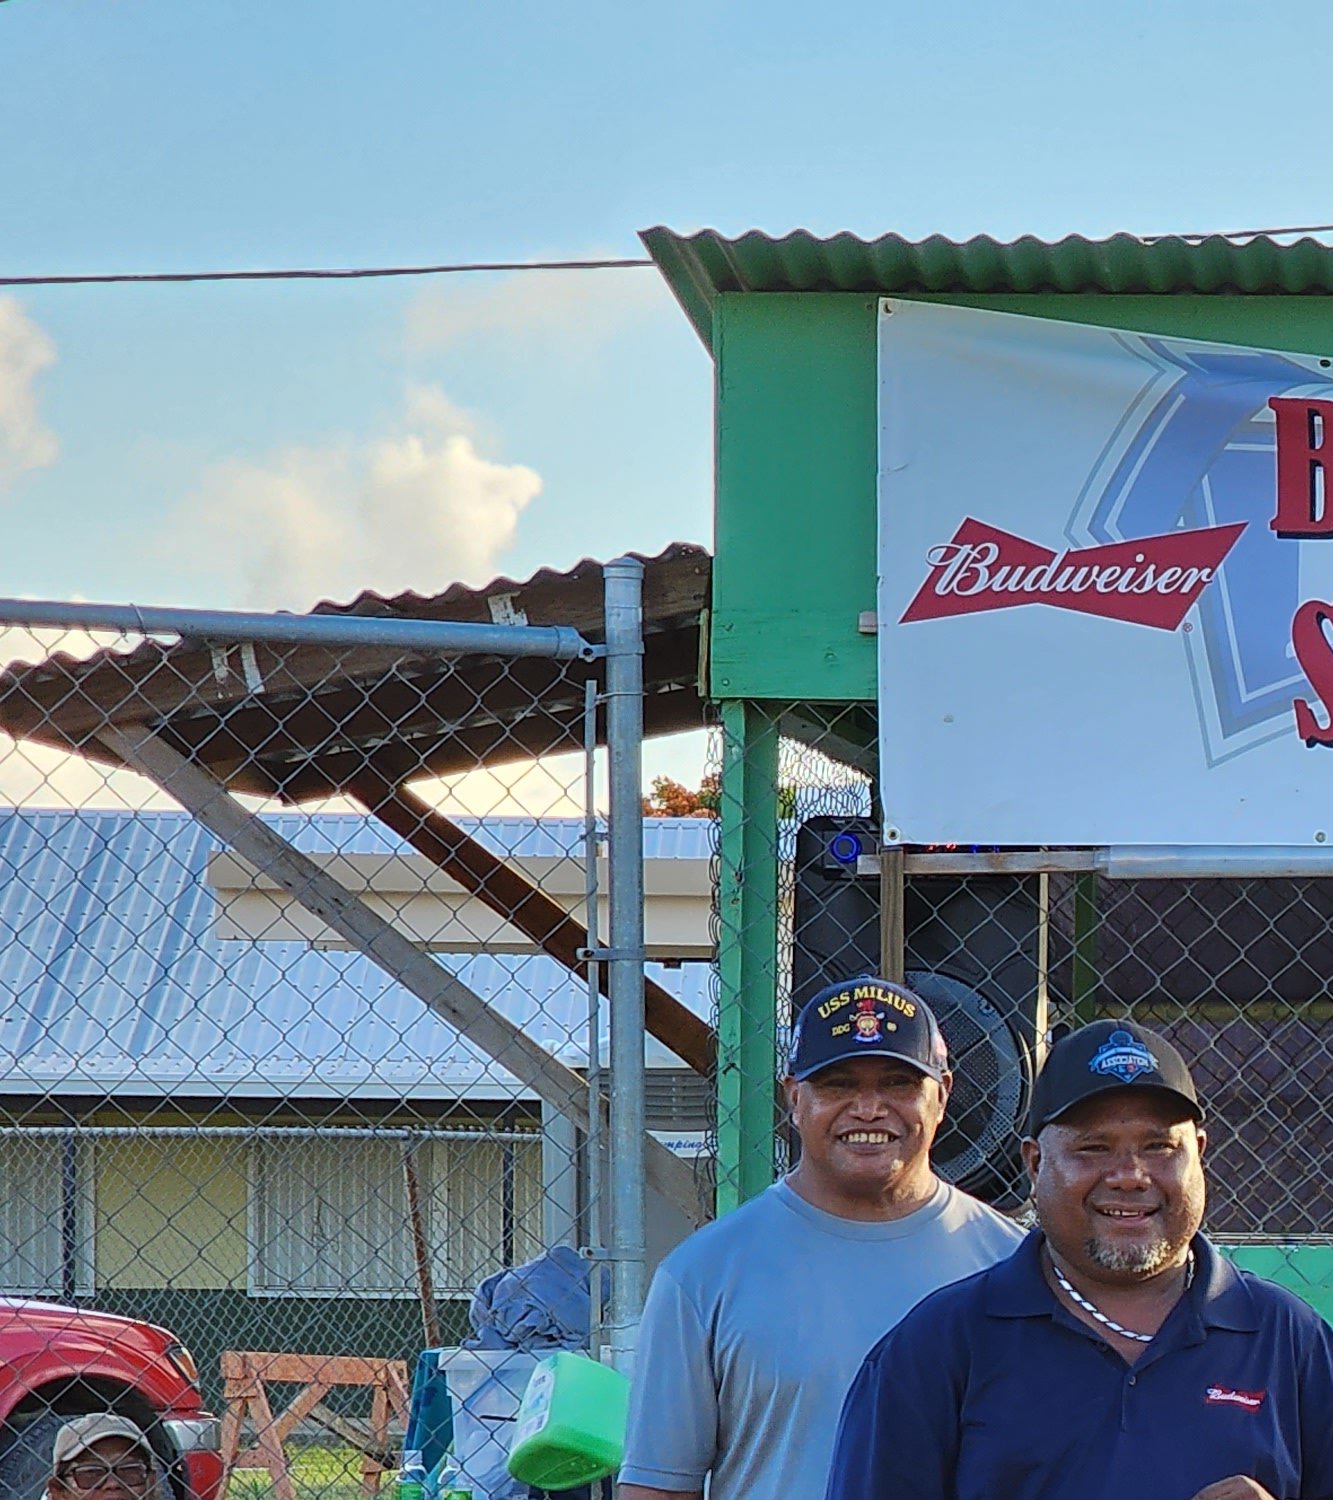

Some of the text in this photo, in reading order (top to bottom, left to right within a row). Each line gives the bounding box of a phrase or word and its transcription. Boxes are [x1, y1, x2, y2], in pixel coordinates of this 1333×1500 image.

[926, 542, 1213, 597] Budweiser
[818, 986, 916, 1018] USS MILIUS
